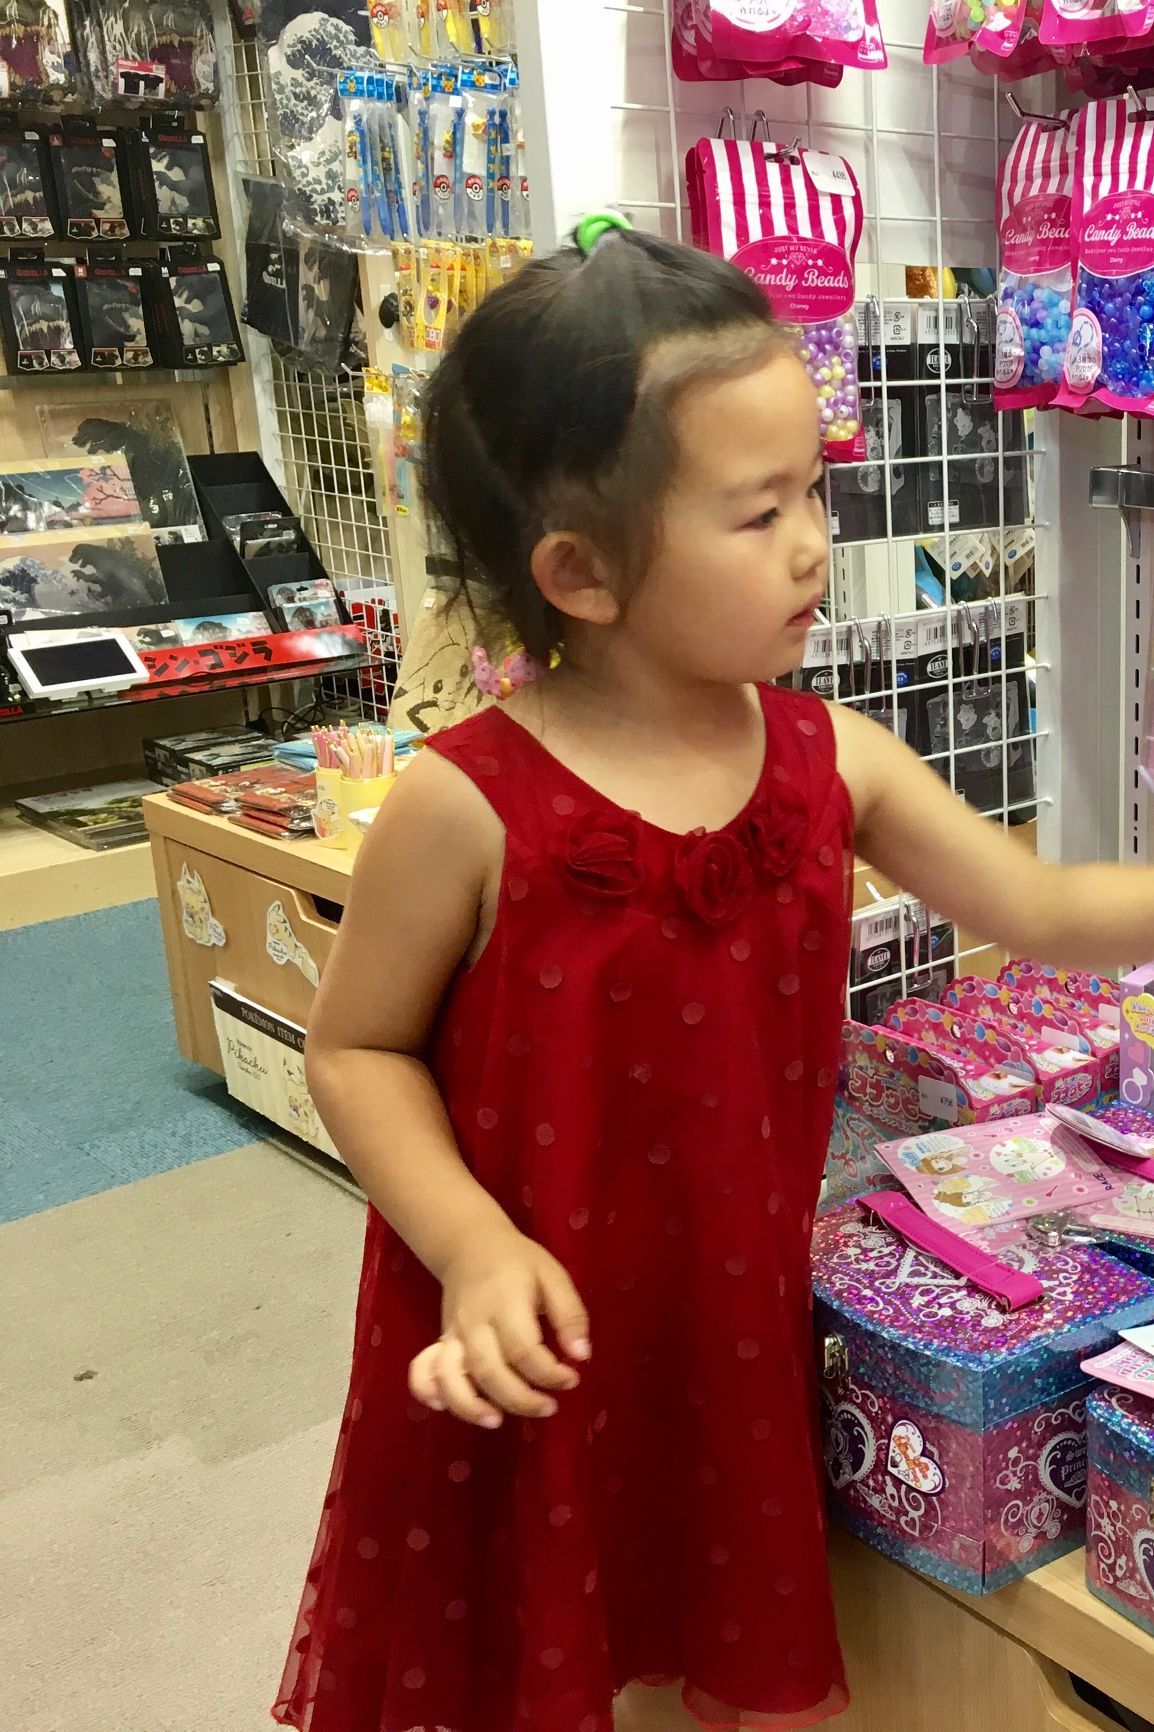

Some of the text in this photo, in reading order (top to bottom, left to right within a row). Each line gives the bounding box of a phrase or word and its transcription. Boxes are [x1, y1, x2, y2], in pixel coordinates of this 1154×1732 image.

[1004, 226, 1035, 250] Candy
[1084, 223, 1122, 246] Candy
[744, 267, 849, 291] Candy Beads
[277, 1026, 296, 1045] ITEM
